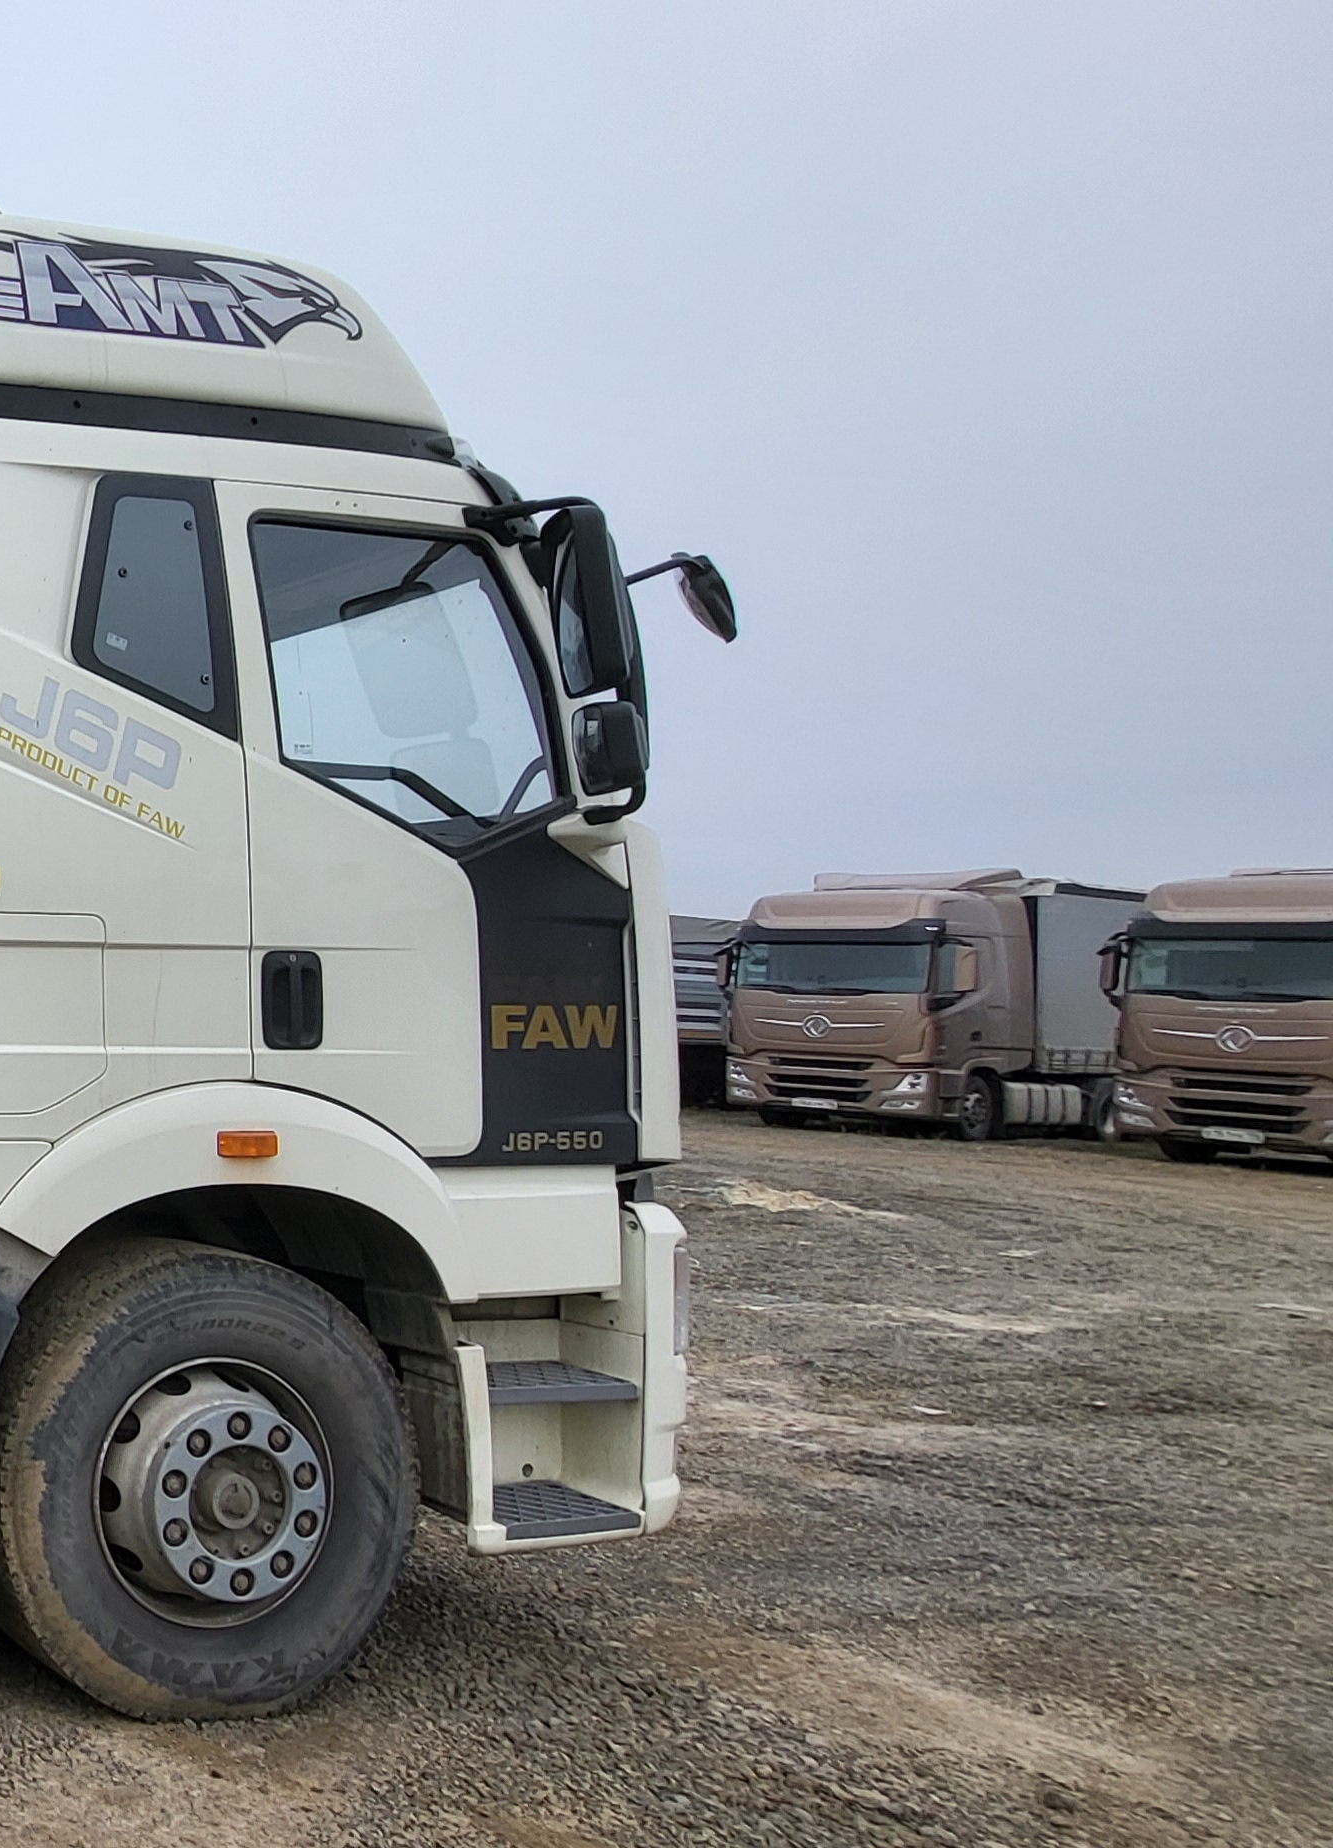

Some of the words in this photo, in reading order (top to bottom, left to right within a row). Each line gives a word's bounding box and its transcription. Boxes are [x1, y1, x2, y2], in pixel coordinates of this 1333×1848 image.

[15, 240, 245, 343] AMT
[102, 784, 133, 809] OF
[136, 801, 186, 839] FAW
[490, 1004, 618, 1050] FAW
[501, 1131, 603, 1152] J6P-550
